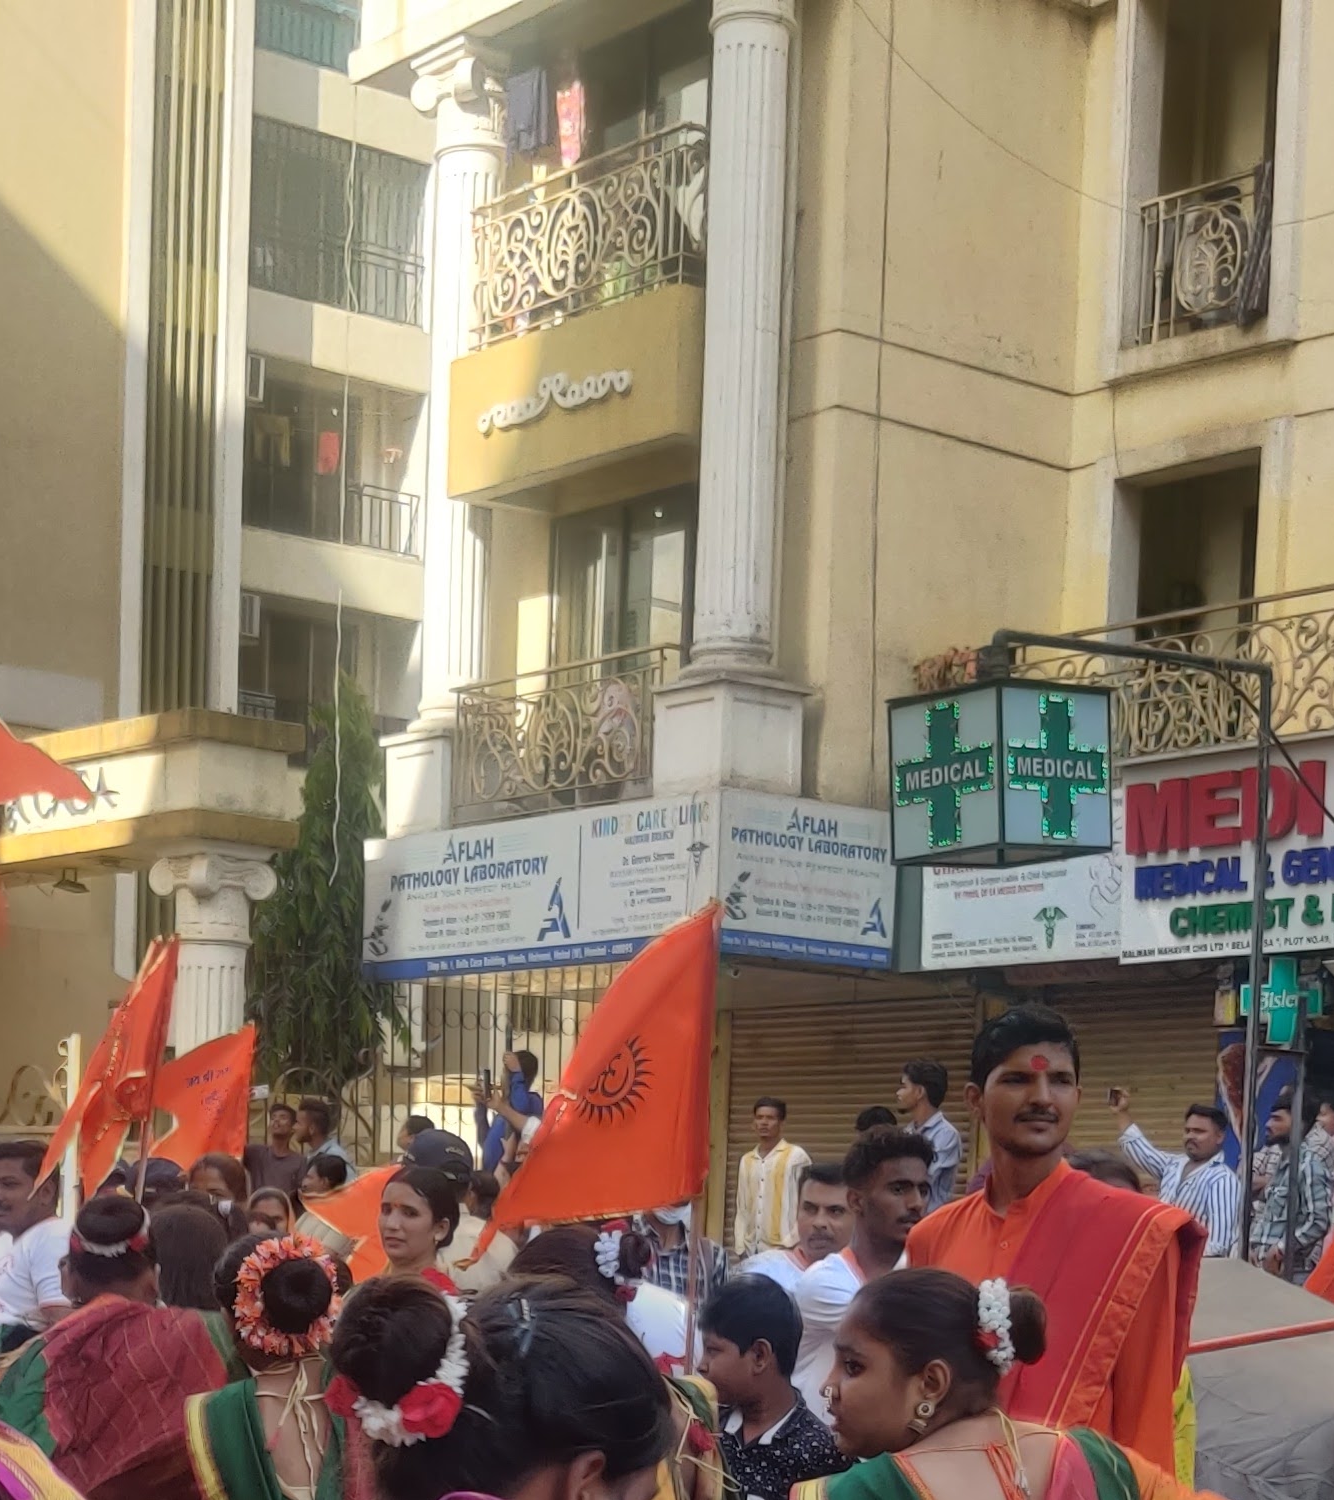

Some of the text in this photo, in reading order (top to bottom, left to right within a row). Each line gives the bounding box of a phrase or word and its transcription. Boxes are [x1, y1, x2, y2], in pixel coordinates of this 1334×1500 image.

[904, 758, 986, 792] MEDICAL
[1016, 756, 1098, 781] MEDICAL
[637, 808, 668, 832] CARE
[786, 807, 838, 838] AFLAH
[1126, 759, 1327, 856] MEDI
[442, 834, 495, 865] AFLAH
[731, 827, 888, 864] PATHOLOGY LABORATORY
[391, 855, 548, 893] PATHOLOGY LABORATORY
[1135, 856, 1248, 902] MEDICAL
[1170, 897, 1295, 938] CHEMST
[1302, 894, 1324, 927] &
[1284, 936, 1304, 946] PLOT
